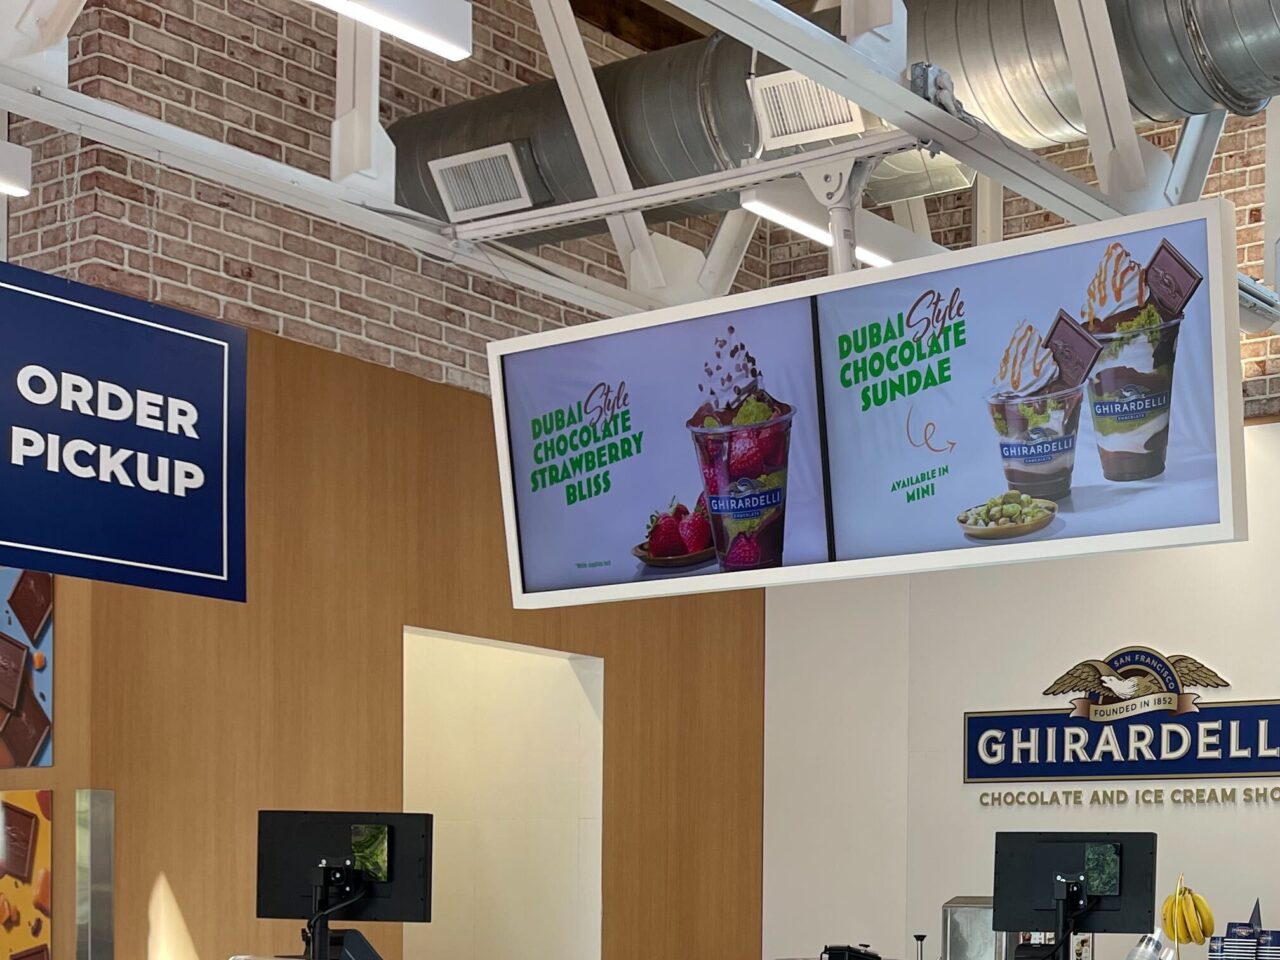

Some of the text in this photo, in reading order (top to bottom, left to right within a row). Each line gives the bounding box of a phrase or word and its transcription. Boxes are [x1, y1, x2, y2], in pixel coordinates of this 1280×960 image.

[837, 287, 965, 360] DUBAI Style
[839, 319, 968, 389] CHOCOLATE
[16, 364, 200, 439] ORDER
[859, 357, 952, 412] SUNDAE
[530, 381, 630, 440] DUBAI Style
[1094, 396, 1167, 415] GHIRARDELLI
[532, 408, 632, 465] CHOCOLATE
[1002, 440, 1073, 457] GHIRARDELLI
[10, 425, 206, 498] PICKUP
[530, 430, 645, 493] STRAWBERRY
[890, 465, 950, 494] AVAILABLE IN
[564, 469, 612, 507] BLISS
[711, 491, 781, 511] GHIRARDELLI
[905, 482, 937, 504] MINI
[1113, 653, 1175, 690] SAN FRANCISCO
[1093, 696, 1173, 718] FOUNDED IN 1852
[979, 789, 1083, 807] CHOCOLATE
[1089, 788, 1129, 806] AND
[1135, 788, 1164, 805] ICE
[1170, 787, 1237, 804] CREAM
